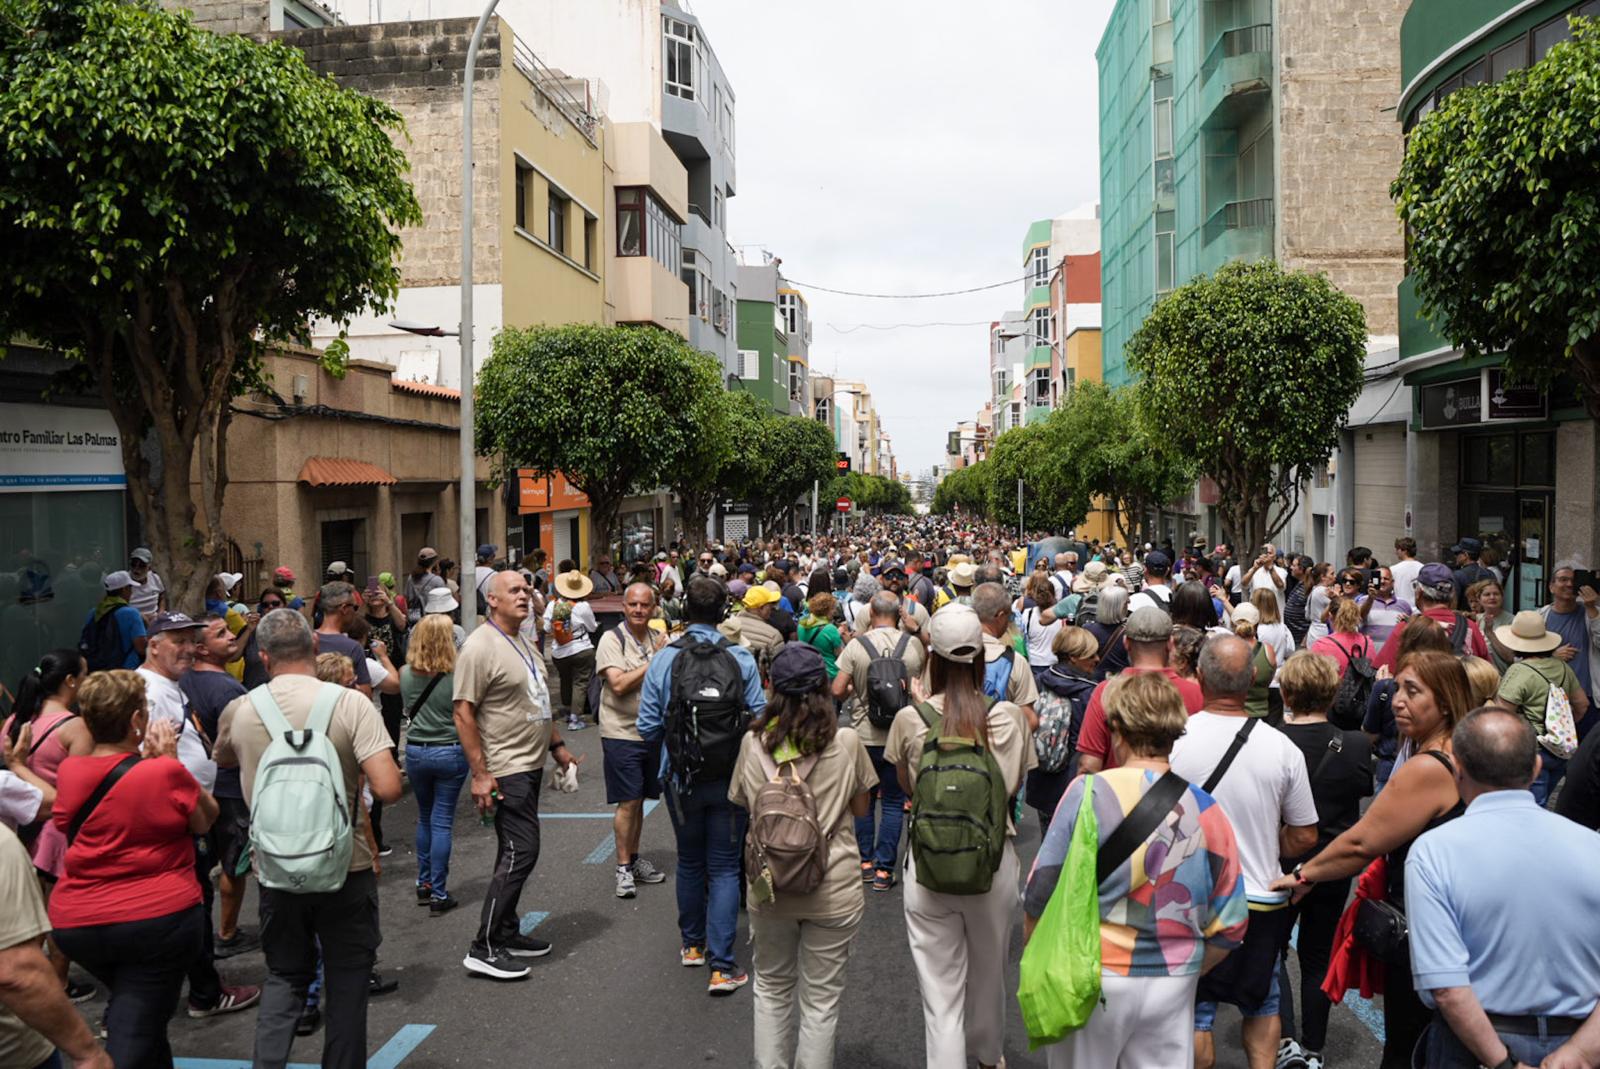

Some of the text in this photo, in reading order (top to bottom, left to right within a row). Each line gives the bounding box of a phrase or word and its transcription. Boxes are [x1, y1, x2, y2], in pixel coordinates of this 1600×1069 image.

[23, 430, 65, 445] Familiar
[67, 432, 83, 445] Las
[85, 432, 117, 446] Palmas
